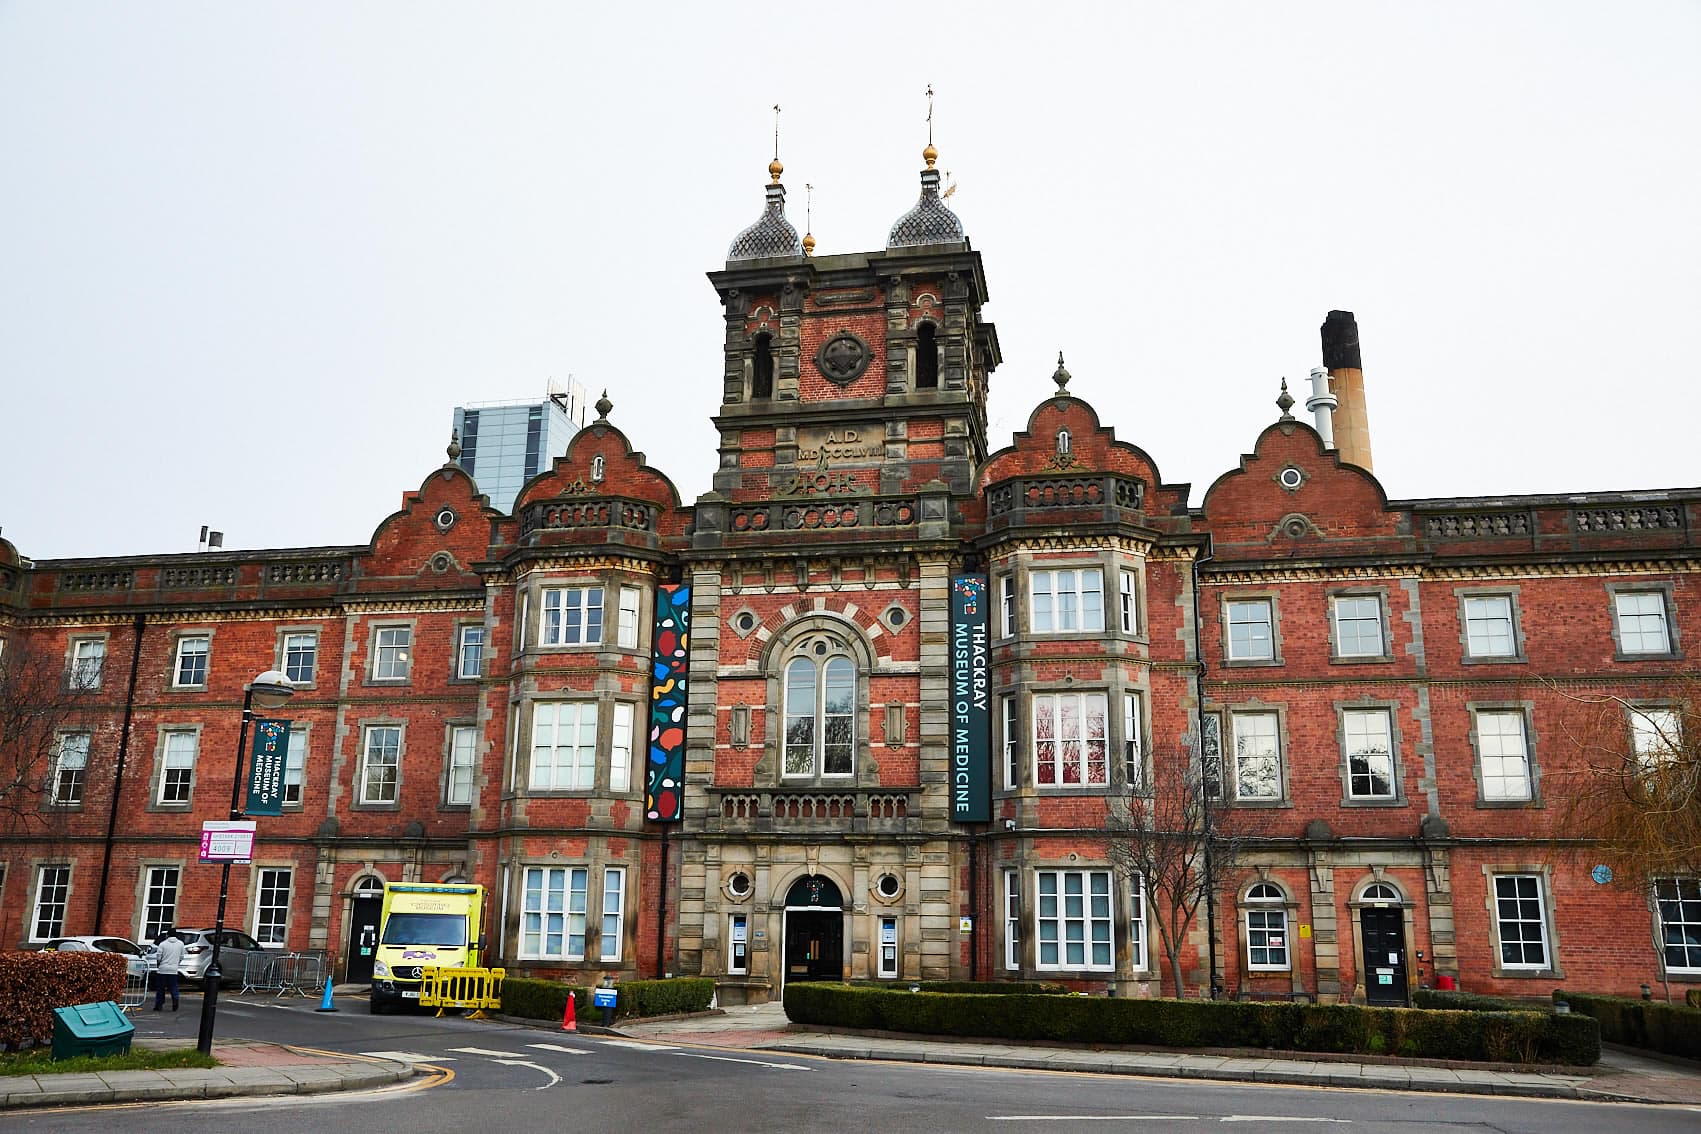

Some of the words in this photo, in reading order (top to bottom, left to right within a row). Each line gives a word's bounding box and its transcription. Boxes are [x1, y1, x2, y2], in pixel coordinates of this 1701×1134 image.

[826, 430, 862, 444] A.D.
[955, 623, 969, 696] MUSEUM
[973, 622, 986, 711] THACKRAY
[956, 701, 969, 724] OF
[253, 754, 264, 795] MEDICINE
[262, 755, 273, 791] MUSEUM
[271, 755, 282, 798] THACKRAY
[956, 729, 969, 813] MEDICINE
[261, 792, 269, 805] OF
